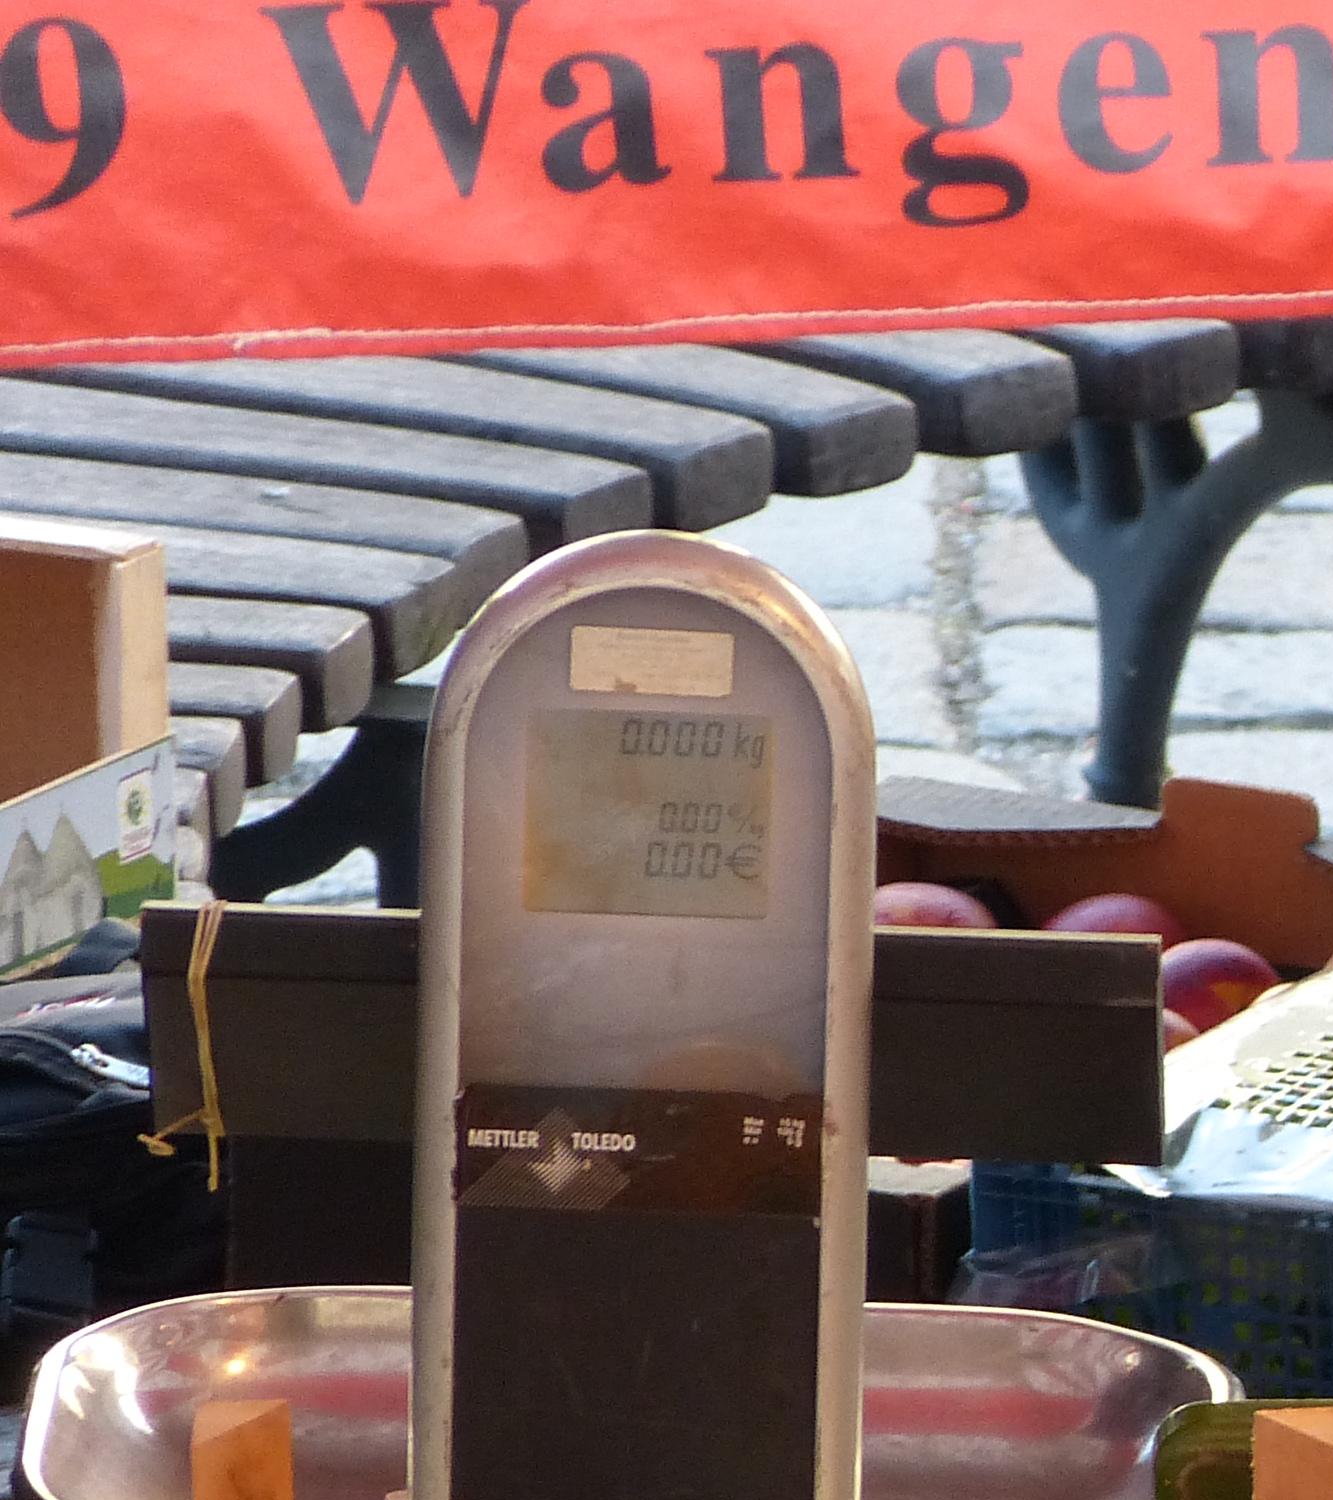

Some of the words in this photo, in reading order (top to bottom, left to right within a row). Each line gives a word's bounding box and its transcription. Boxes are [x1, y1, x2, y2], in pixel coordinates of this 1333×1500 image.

[0, 15, 127, 217] 9
[467, 1128, 539, 1149] METTLER
[572, 1131, 636, 1151] TOLEDO
